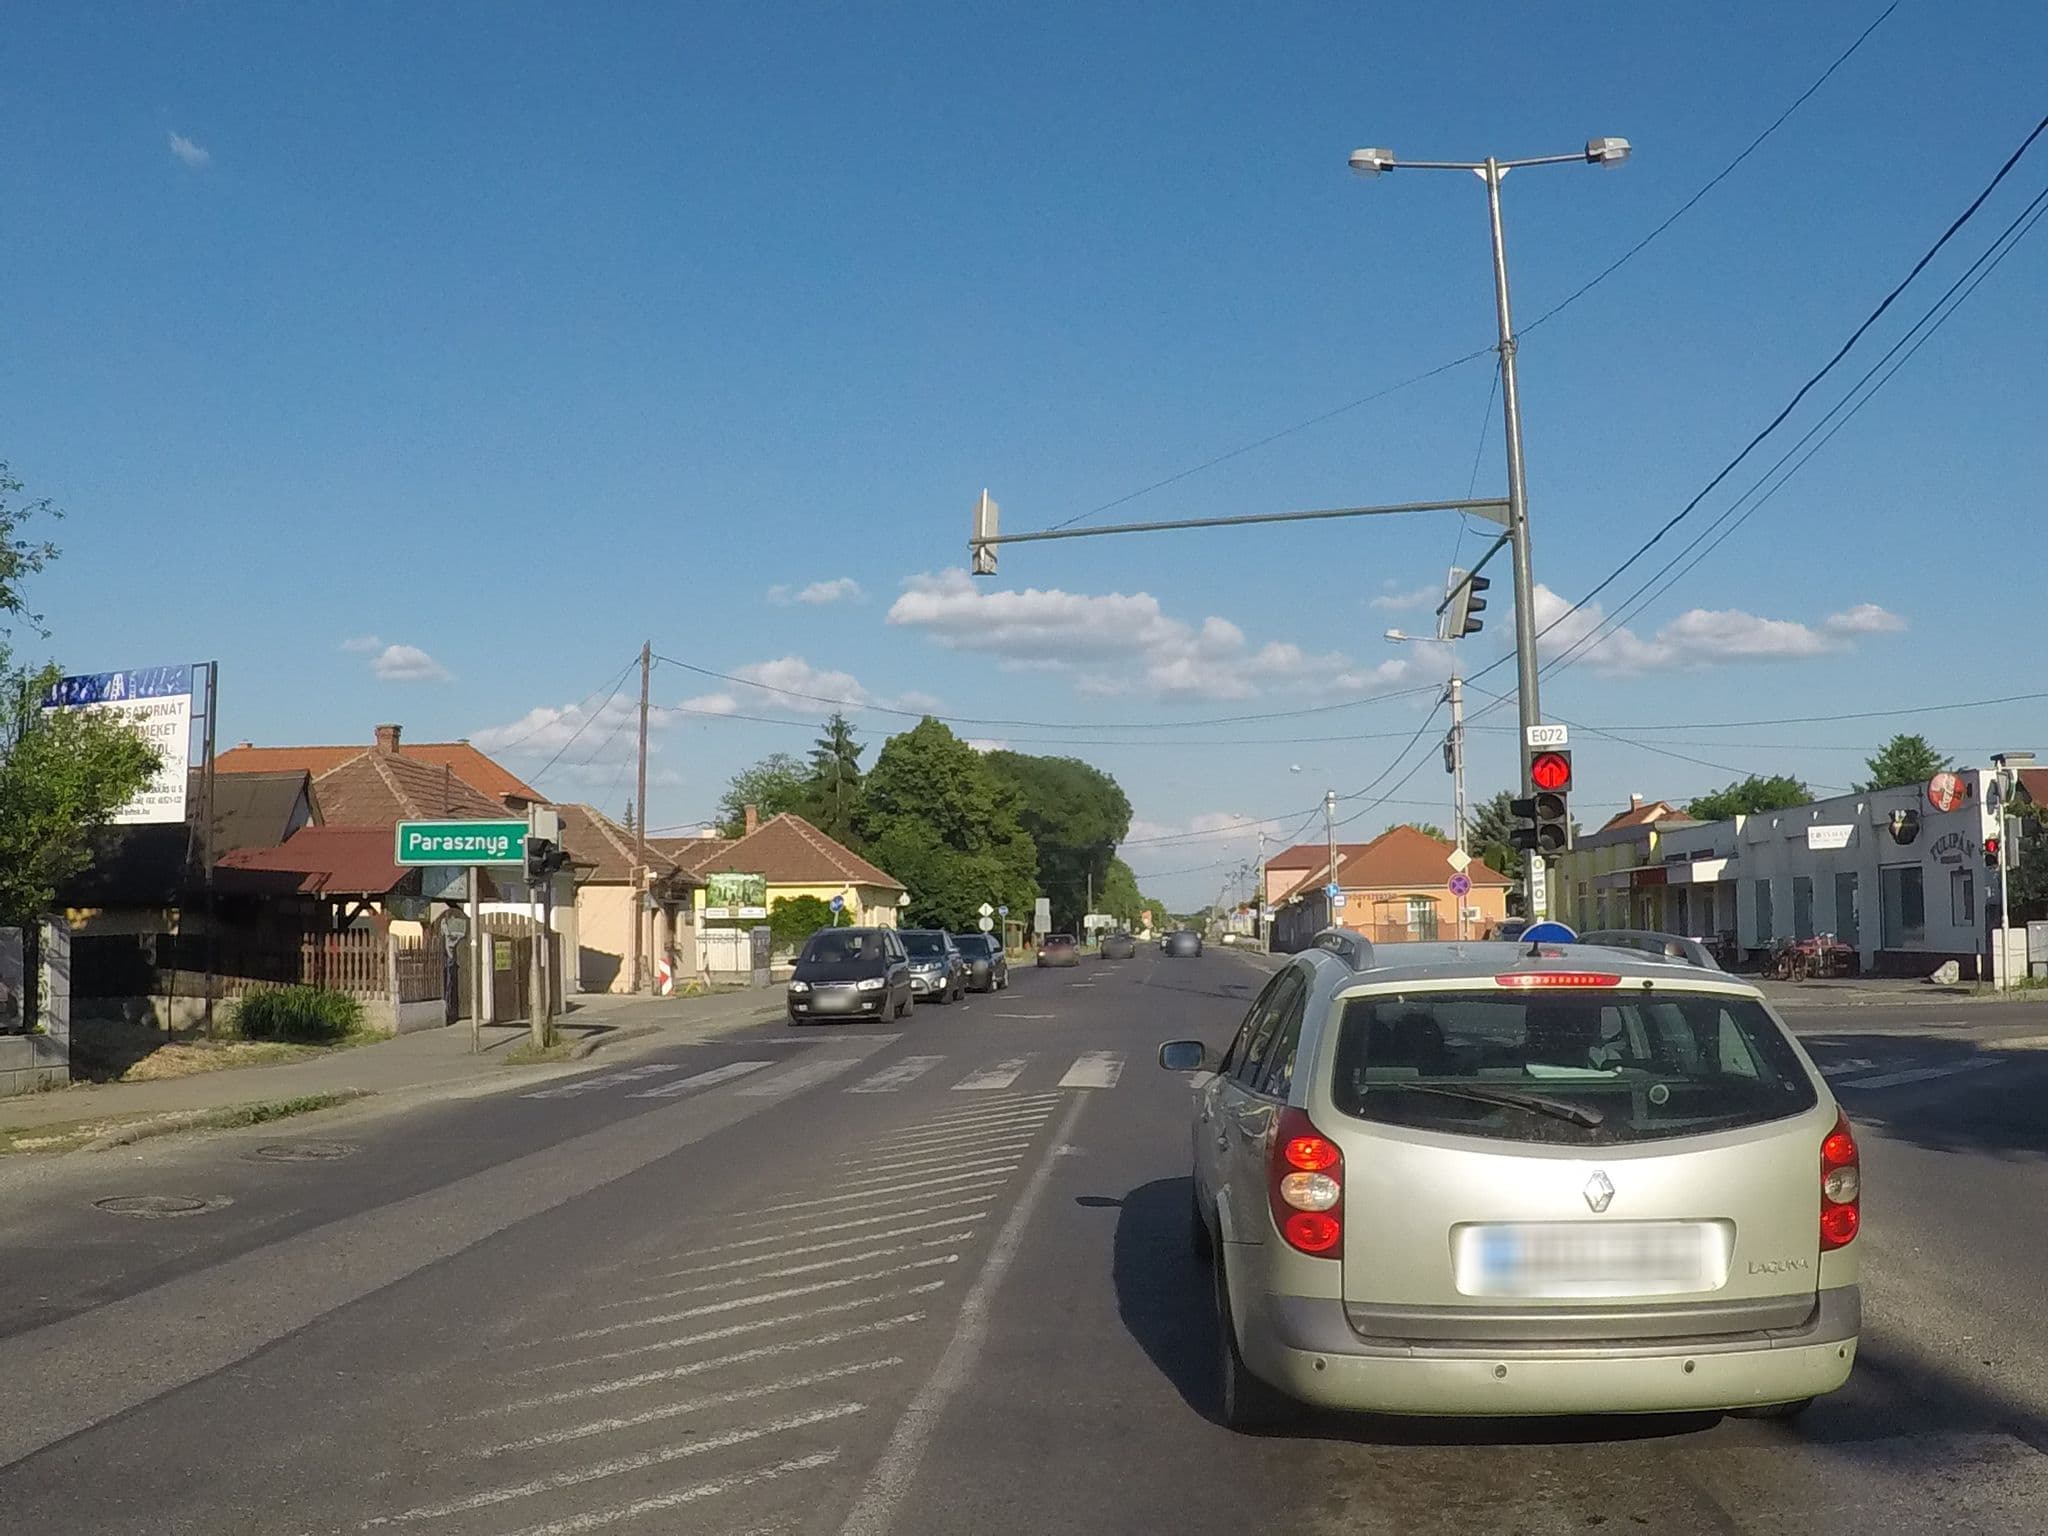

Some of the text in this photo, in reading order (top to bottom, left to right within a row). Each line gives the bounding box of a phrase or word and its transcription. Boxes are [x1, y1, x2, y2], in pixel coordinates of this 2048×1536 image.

[1532, 729, 1563, 742] E072
[409, 833, 508, 855] Parasznya
[1930, 831, 1975, 861] TULIPÁN
[1748, 1258, 1809, 1275] LAGUNA
